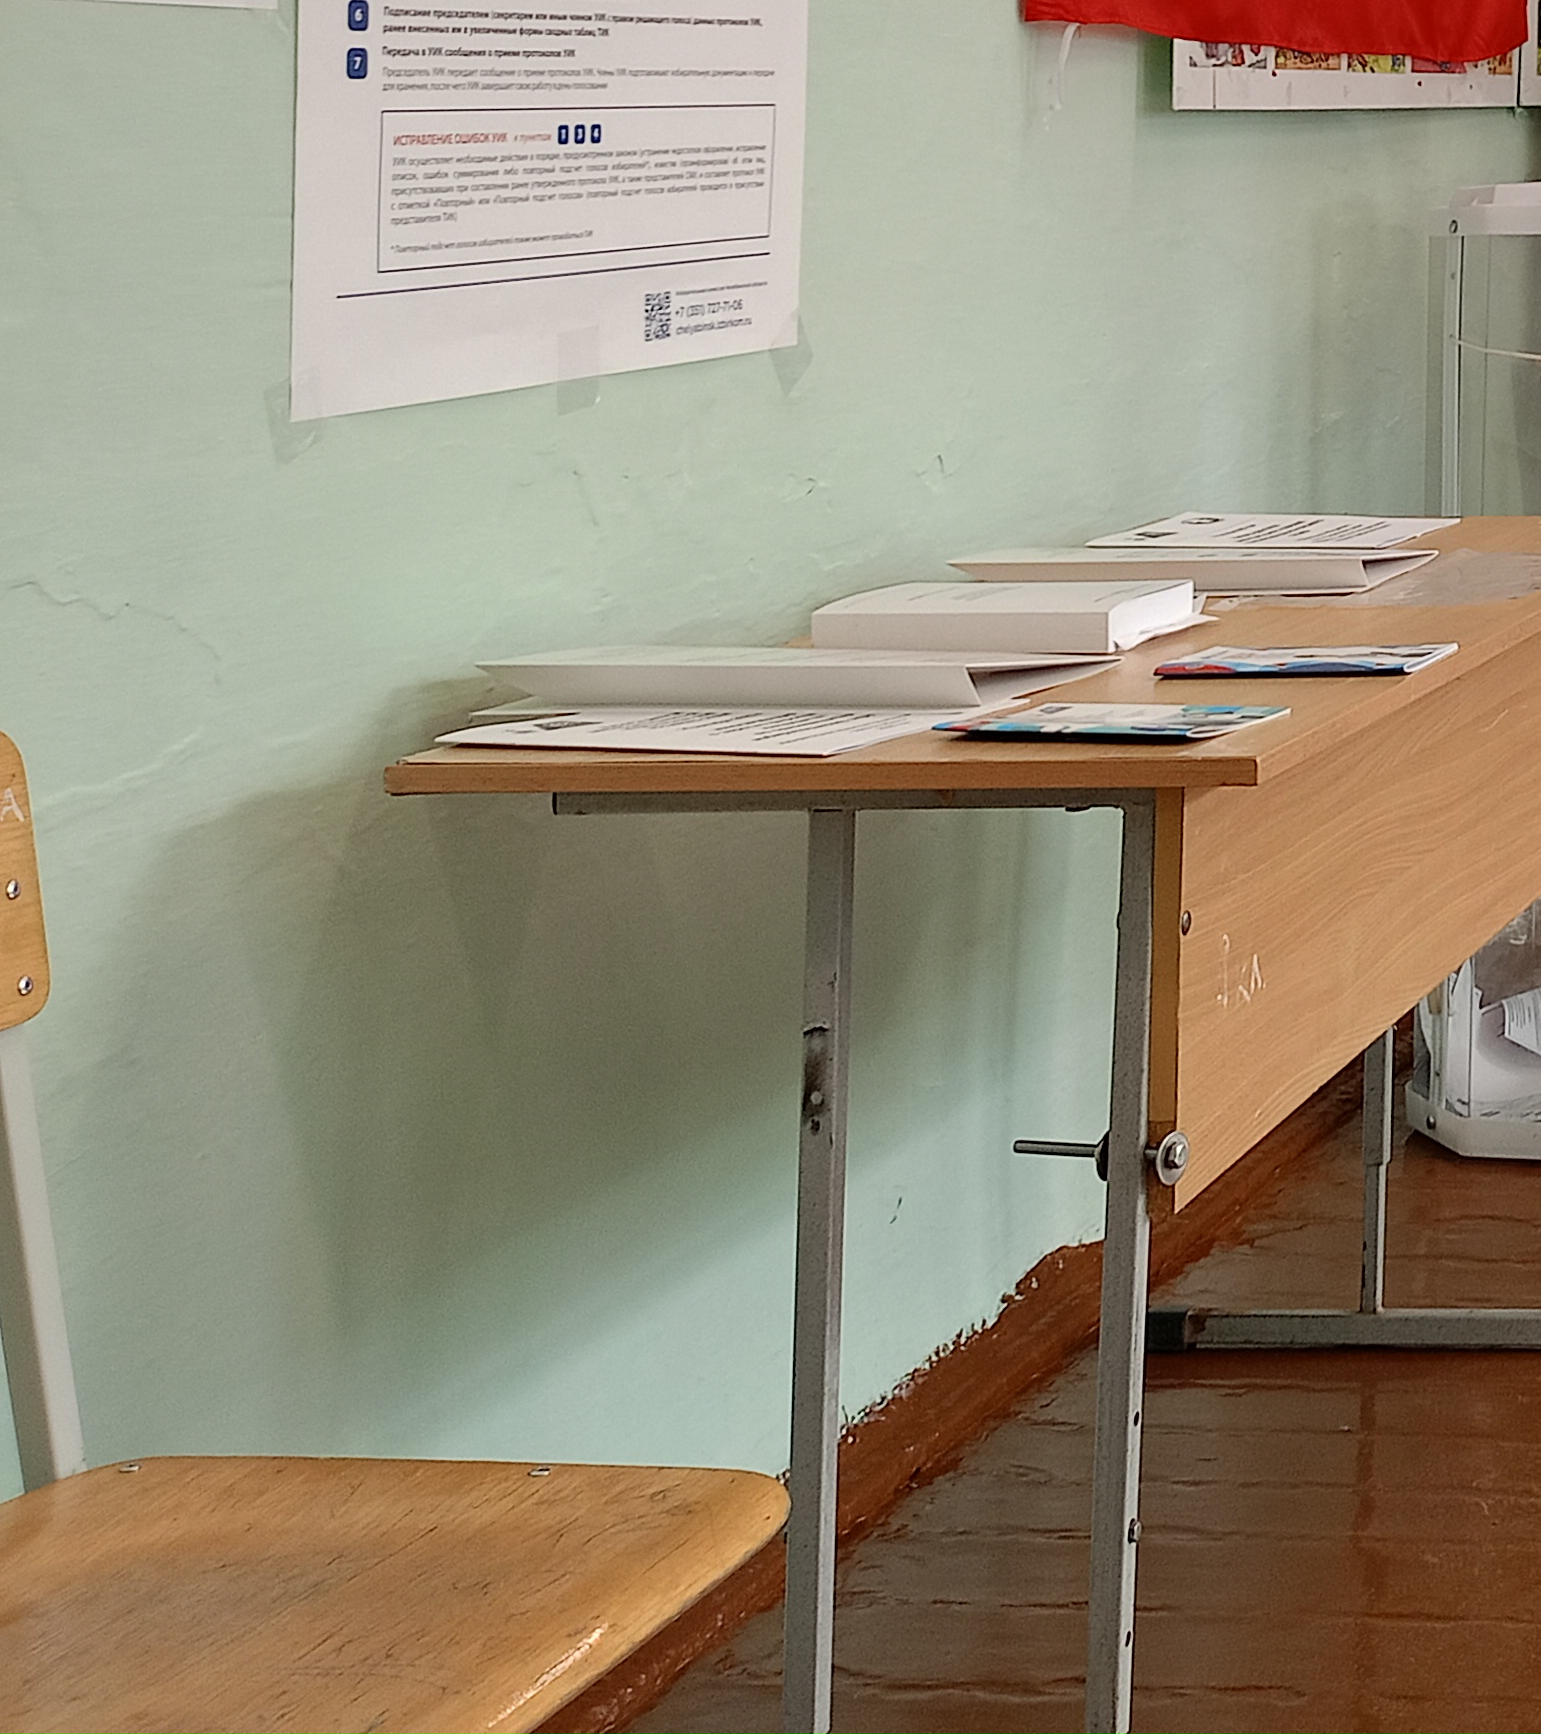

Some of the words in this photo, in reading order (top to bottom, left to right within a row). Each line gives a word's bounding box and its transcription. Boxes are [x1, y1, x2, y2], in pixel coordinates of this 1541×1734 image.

[354, 8, 362, 22] 6
[353, 56, 362, 70] 7
[393, 132, 453, 147] ИСПРАВЛЕНИЕ
